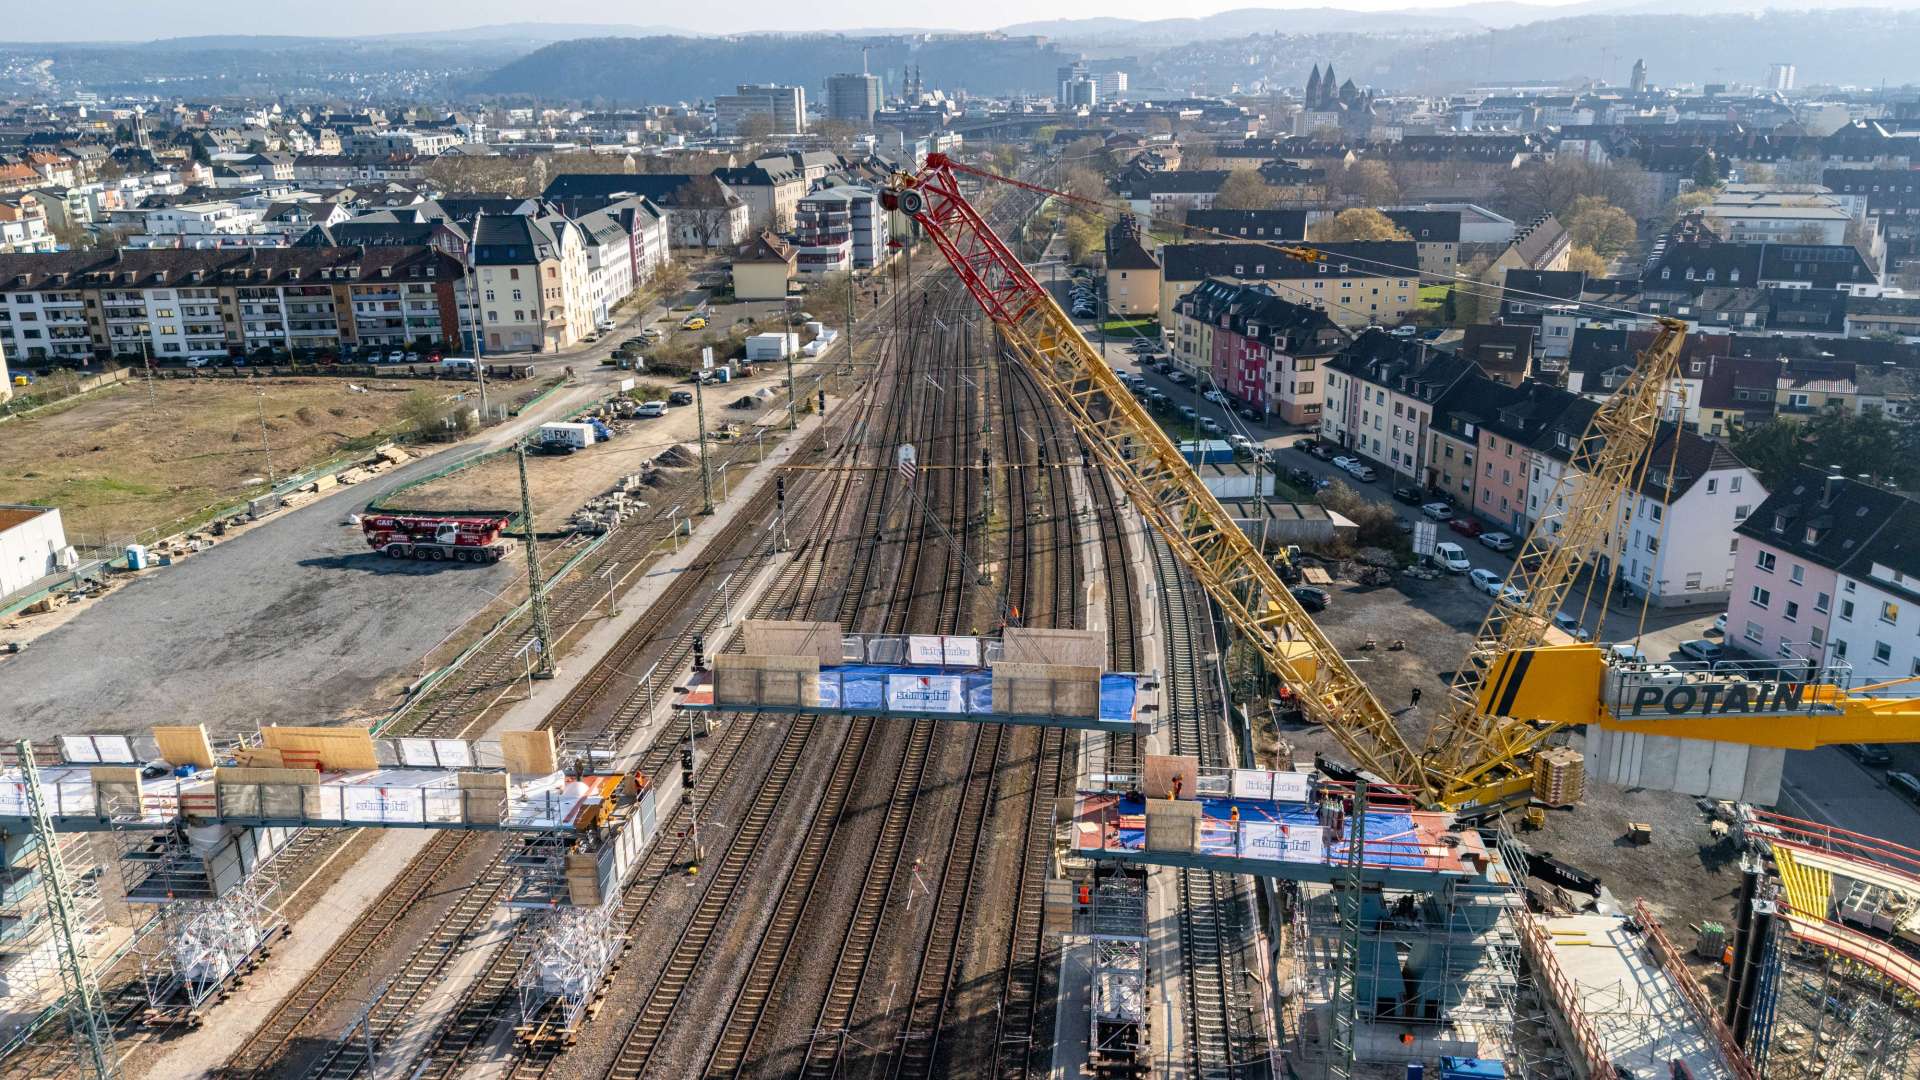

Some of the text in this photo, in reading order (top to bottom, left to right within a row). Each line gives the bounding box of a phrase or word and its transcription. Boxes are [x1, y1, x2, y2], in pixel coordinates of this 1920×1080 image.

[1061, 341, 1082, 368] STEIL
[1632, 683, 1805, 716] POTAIN
[1324, 761, 1343, 774] STEIL
[1555, 867, 1581, 884] STEIL
